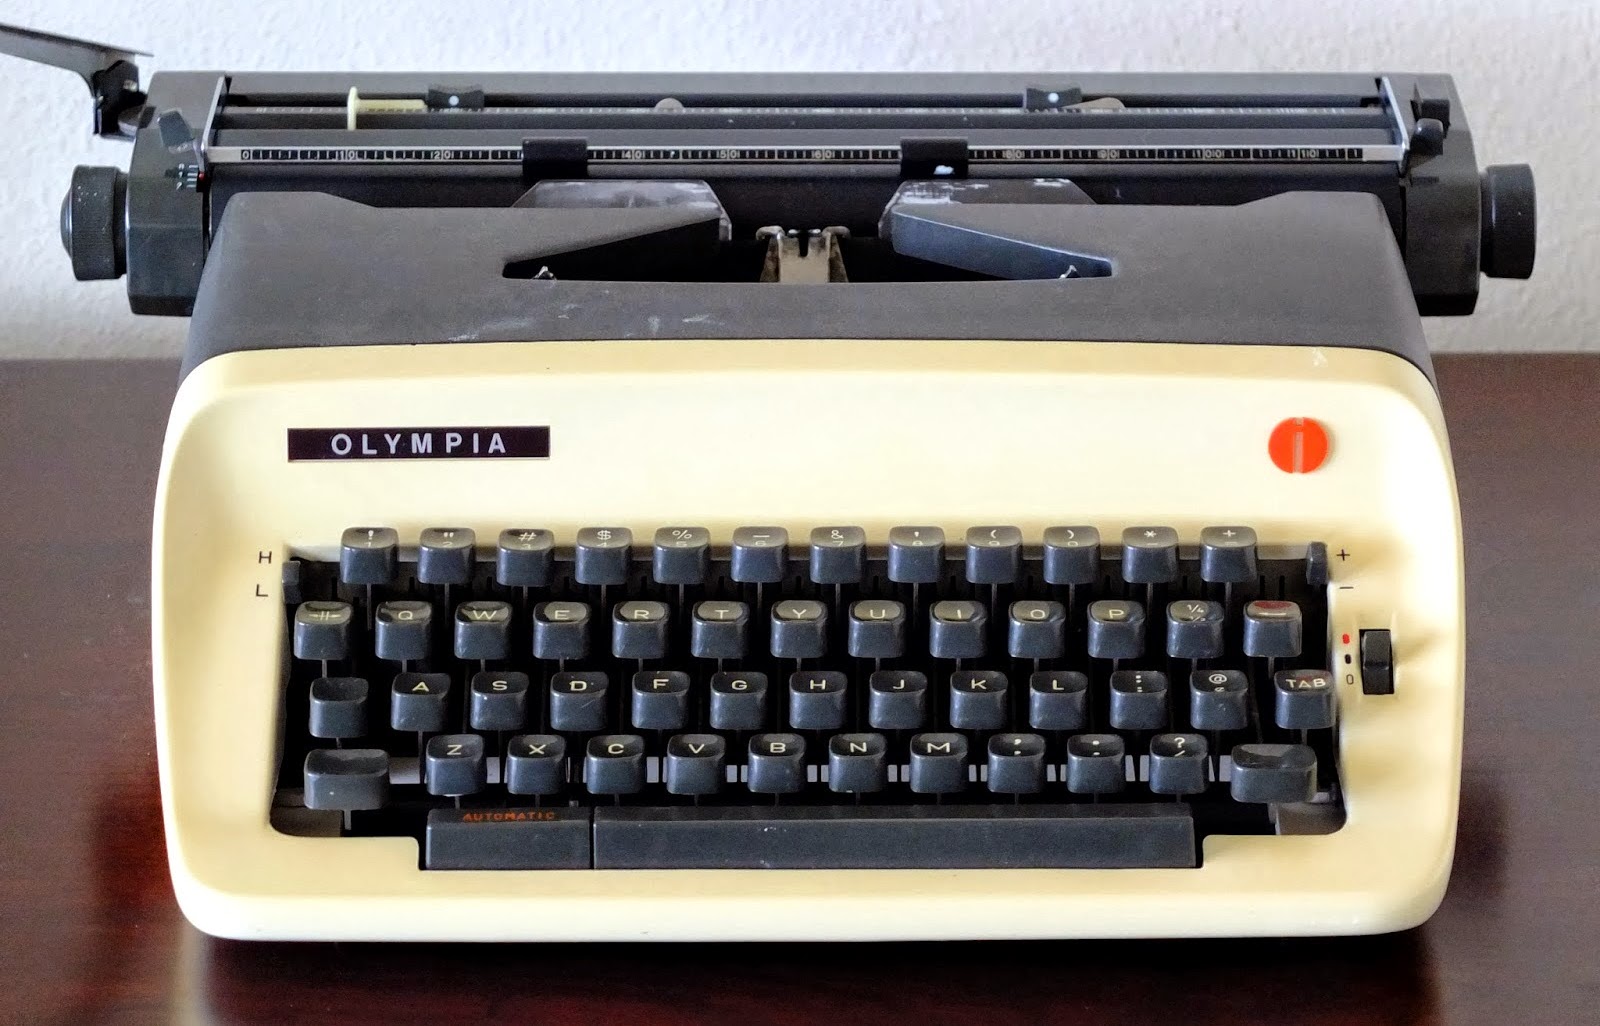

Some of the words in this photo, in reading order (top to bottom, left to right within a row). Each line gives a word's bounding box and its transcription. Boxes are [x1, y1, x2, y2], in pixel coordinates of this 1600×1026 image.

[434, 150, 451, 159] 20
[625, 150, 642, 159] 40
[720, 150, 736, 159] 50
[331, 432, 506, 455] OLYMPIA
[518, 532, 536, 542] #
[597, 530, 611, 540] $
[672, 530, 692, 539] %
[831, 530, 844, 539] &
[258, 551, 272, 564] H
[255, 584, 269, 597] L
[398, 610, 413, 621] Q
[472, 610, 497, 620] W
[554, 610, 570, 620] E
[634, 609, 650, 620] R
[715, 609, 729, 620] T
[792, 609, 807, 619] Y
[869, 609, 886, 619] U
[956, 609, 962, 619] I
[1030, 609, 1046, 620] O
[1108, 609, 1125, 619] P
[653, 678, 669, 690] F
[1208, 673, 1227, 684] @
[1285, 678, 1326, 689] TAB
[412, 681, 430, 692] A
[492, 680, 508, 691] S
[570, 680, 587, 691] D
[731, 679, 748, 691] G
[809, 679, 826, 690] H
[893, 679, 905, 690] J
[971, 679, 987, 690] K
[1052, 679, 1064, 691] L
[770, 742, 786, 753] B
[850, 742, 868, 753] N
[927, 742, 950, 753] M
[1174, 737, 1185, 747] ?
[447, 744, 462, 755] Z
[528, 744, 546, 755] X
[608, 743, 624, 755] C
[688, 744, 705, 754] V
[463, 811, 555, 821] AUTOMATIC
